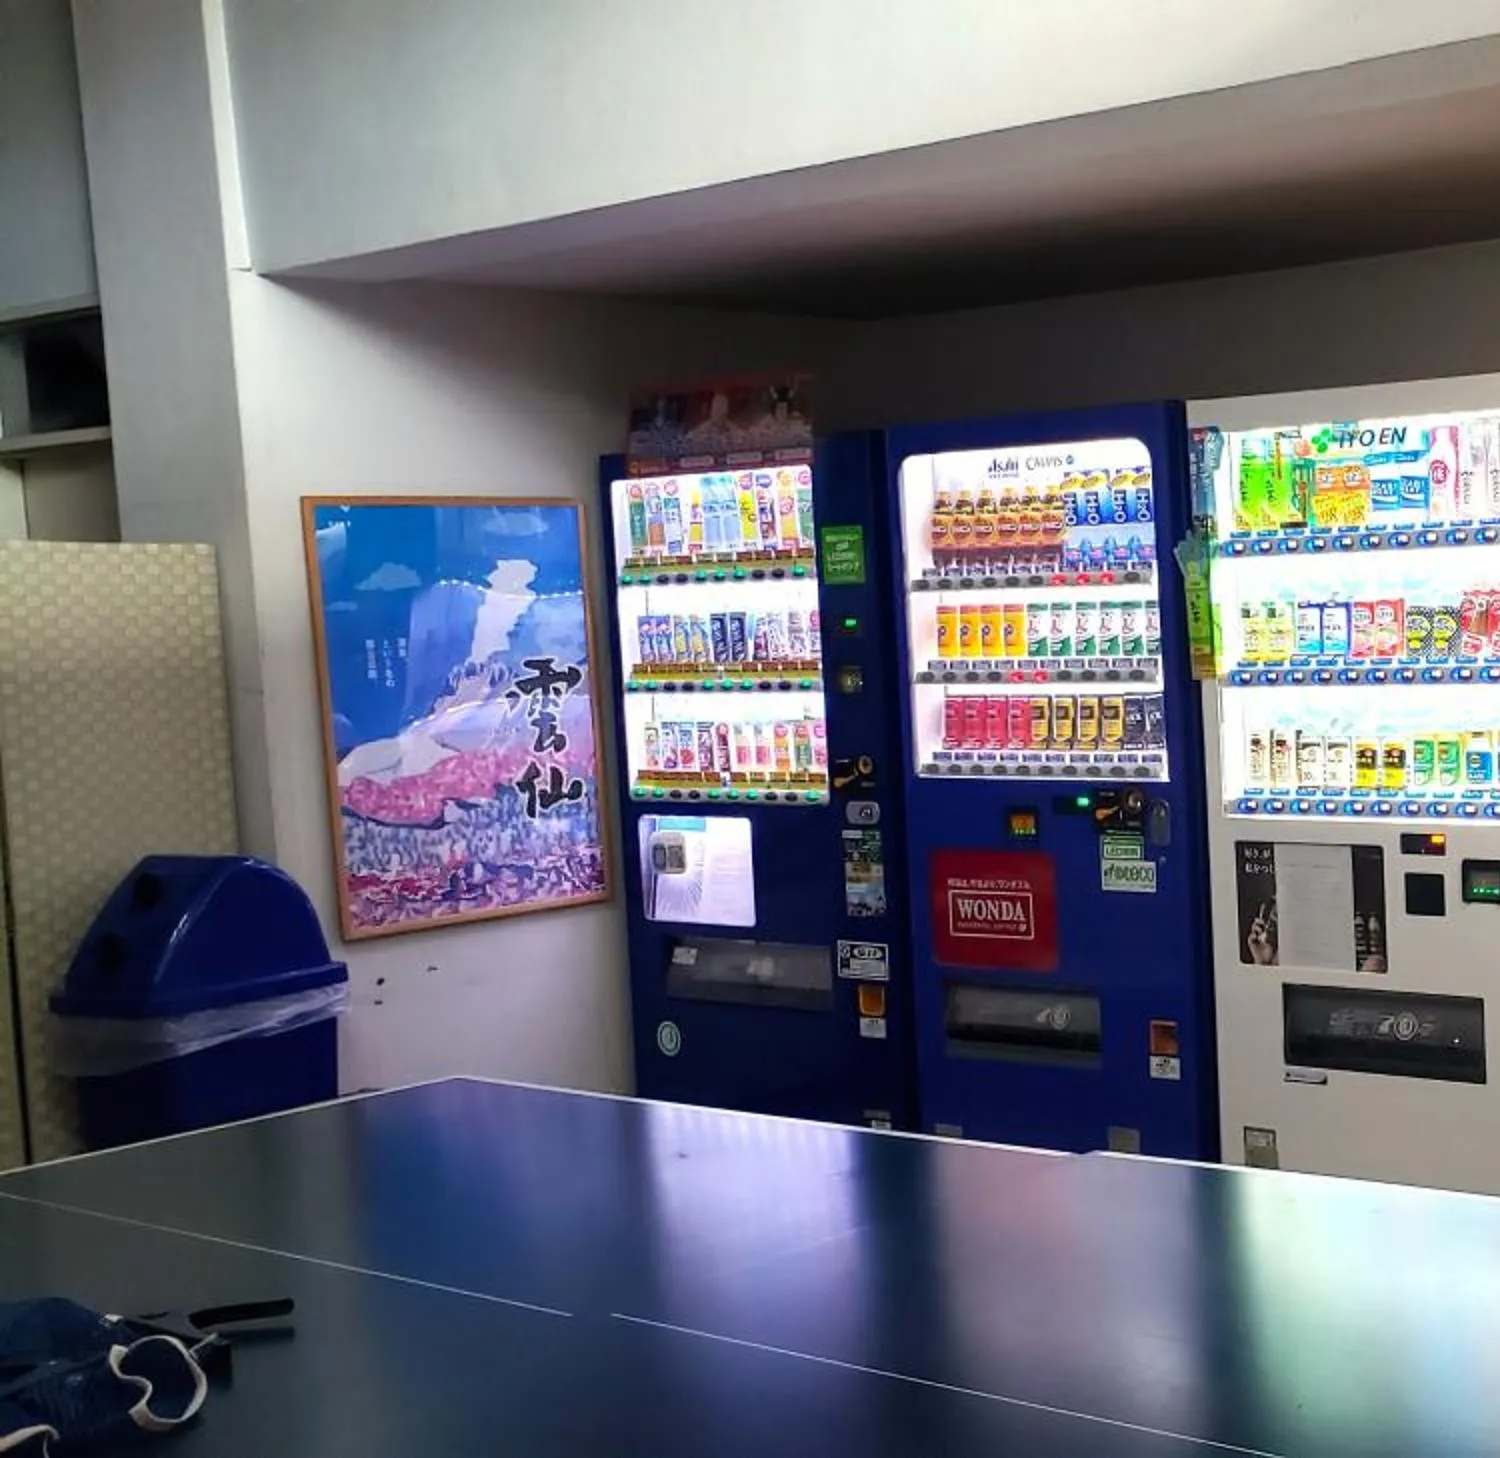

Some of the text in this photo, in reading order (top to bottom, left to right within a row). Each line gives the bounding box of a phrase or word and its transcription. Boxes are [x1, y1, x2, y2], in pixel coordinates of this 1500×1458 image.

[1379, 427, 1408, 446] EN
[505, 657, 583, 819] 雲仙
[957, 898, 1026, 922] WONDA
